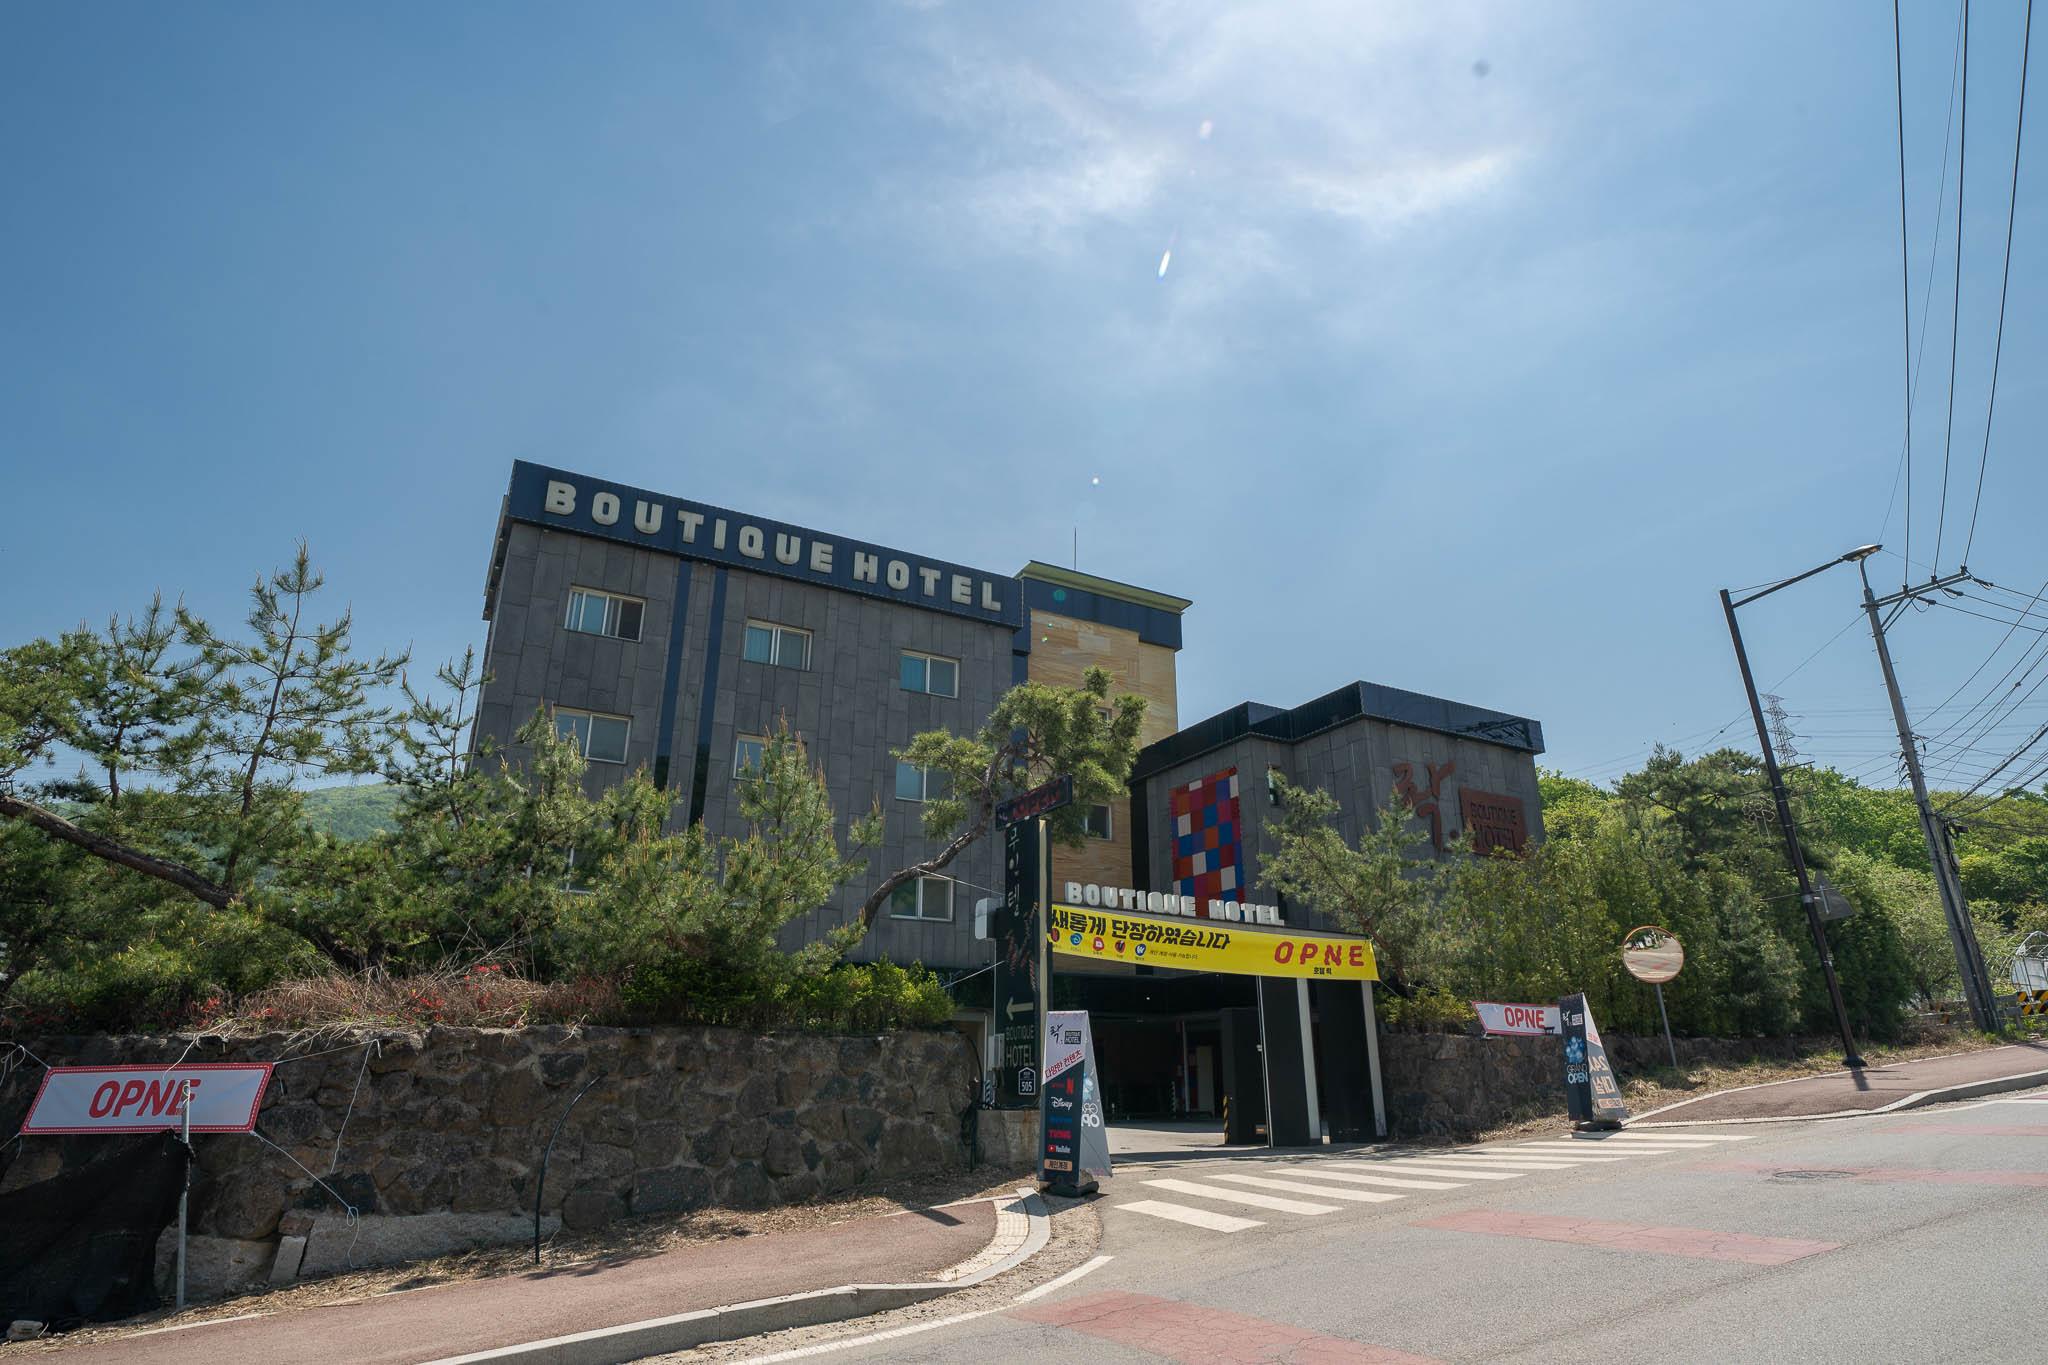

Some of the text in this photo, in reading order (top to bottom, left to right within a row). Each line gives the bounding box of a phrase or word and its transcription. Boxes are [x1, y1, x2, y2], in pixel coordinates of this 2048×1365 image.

[544, 480, 1001, 611] BOUTIQUE HOTEL
[1008, 827, 1020, 917] 무인텔
[1064, 881, 1285, 926] BOUTIQUE HOTEL
[1051, 909, 1231, 950] 새롭게 단장하였습니다
[1274, 941, 1364, 967] OPNE
[1504, 1007, 1545, 1029] OPNE
[1006, 1044, 1035, 1067] HOTEL
[1045, 1061, 1064, 1078] 다양한
[1566, 1063, 1587, 1073] GRAND
[1567, 1072, 1589, 1084] OPEN
[1021, 1081, 1033, 1092] 505
[89, 1079, 201, 1118] OPNE
[1050, 1096, 1073, 1111] Disney
